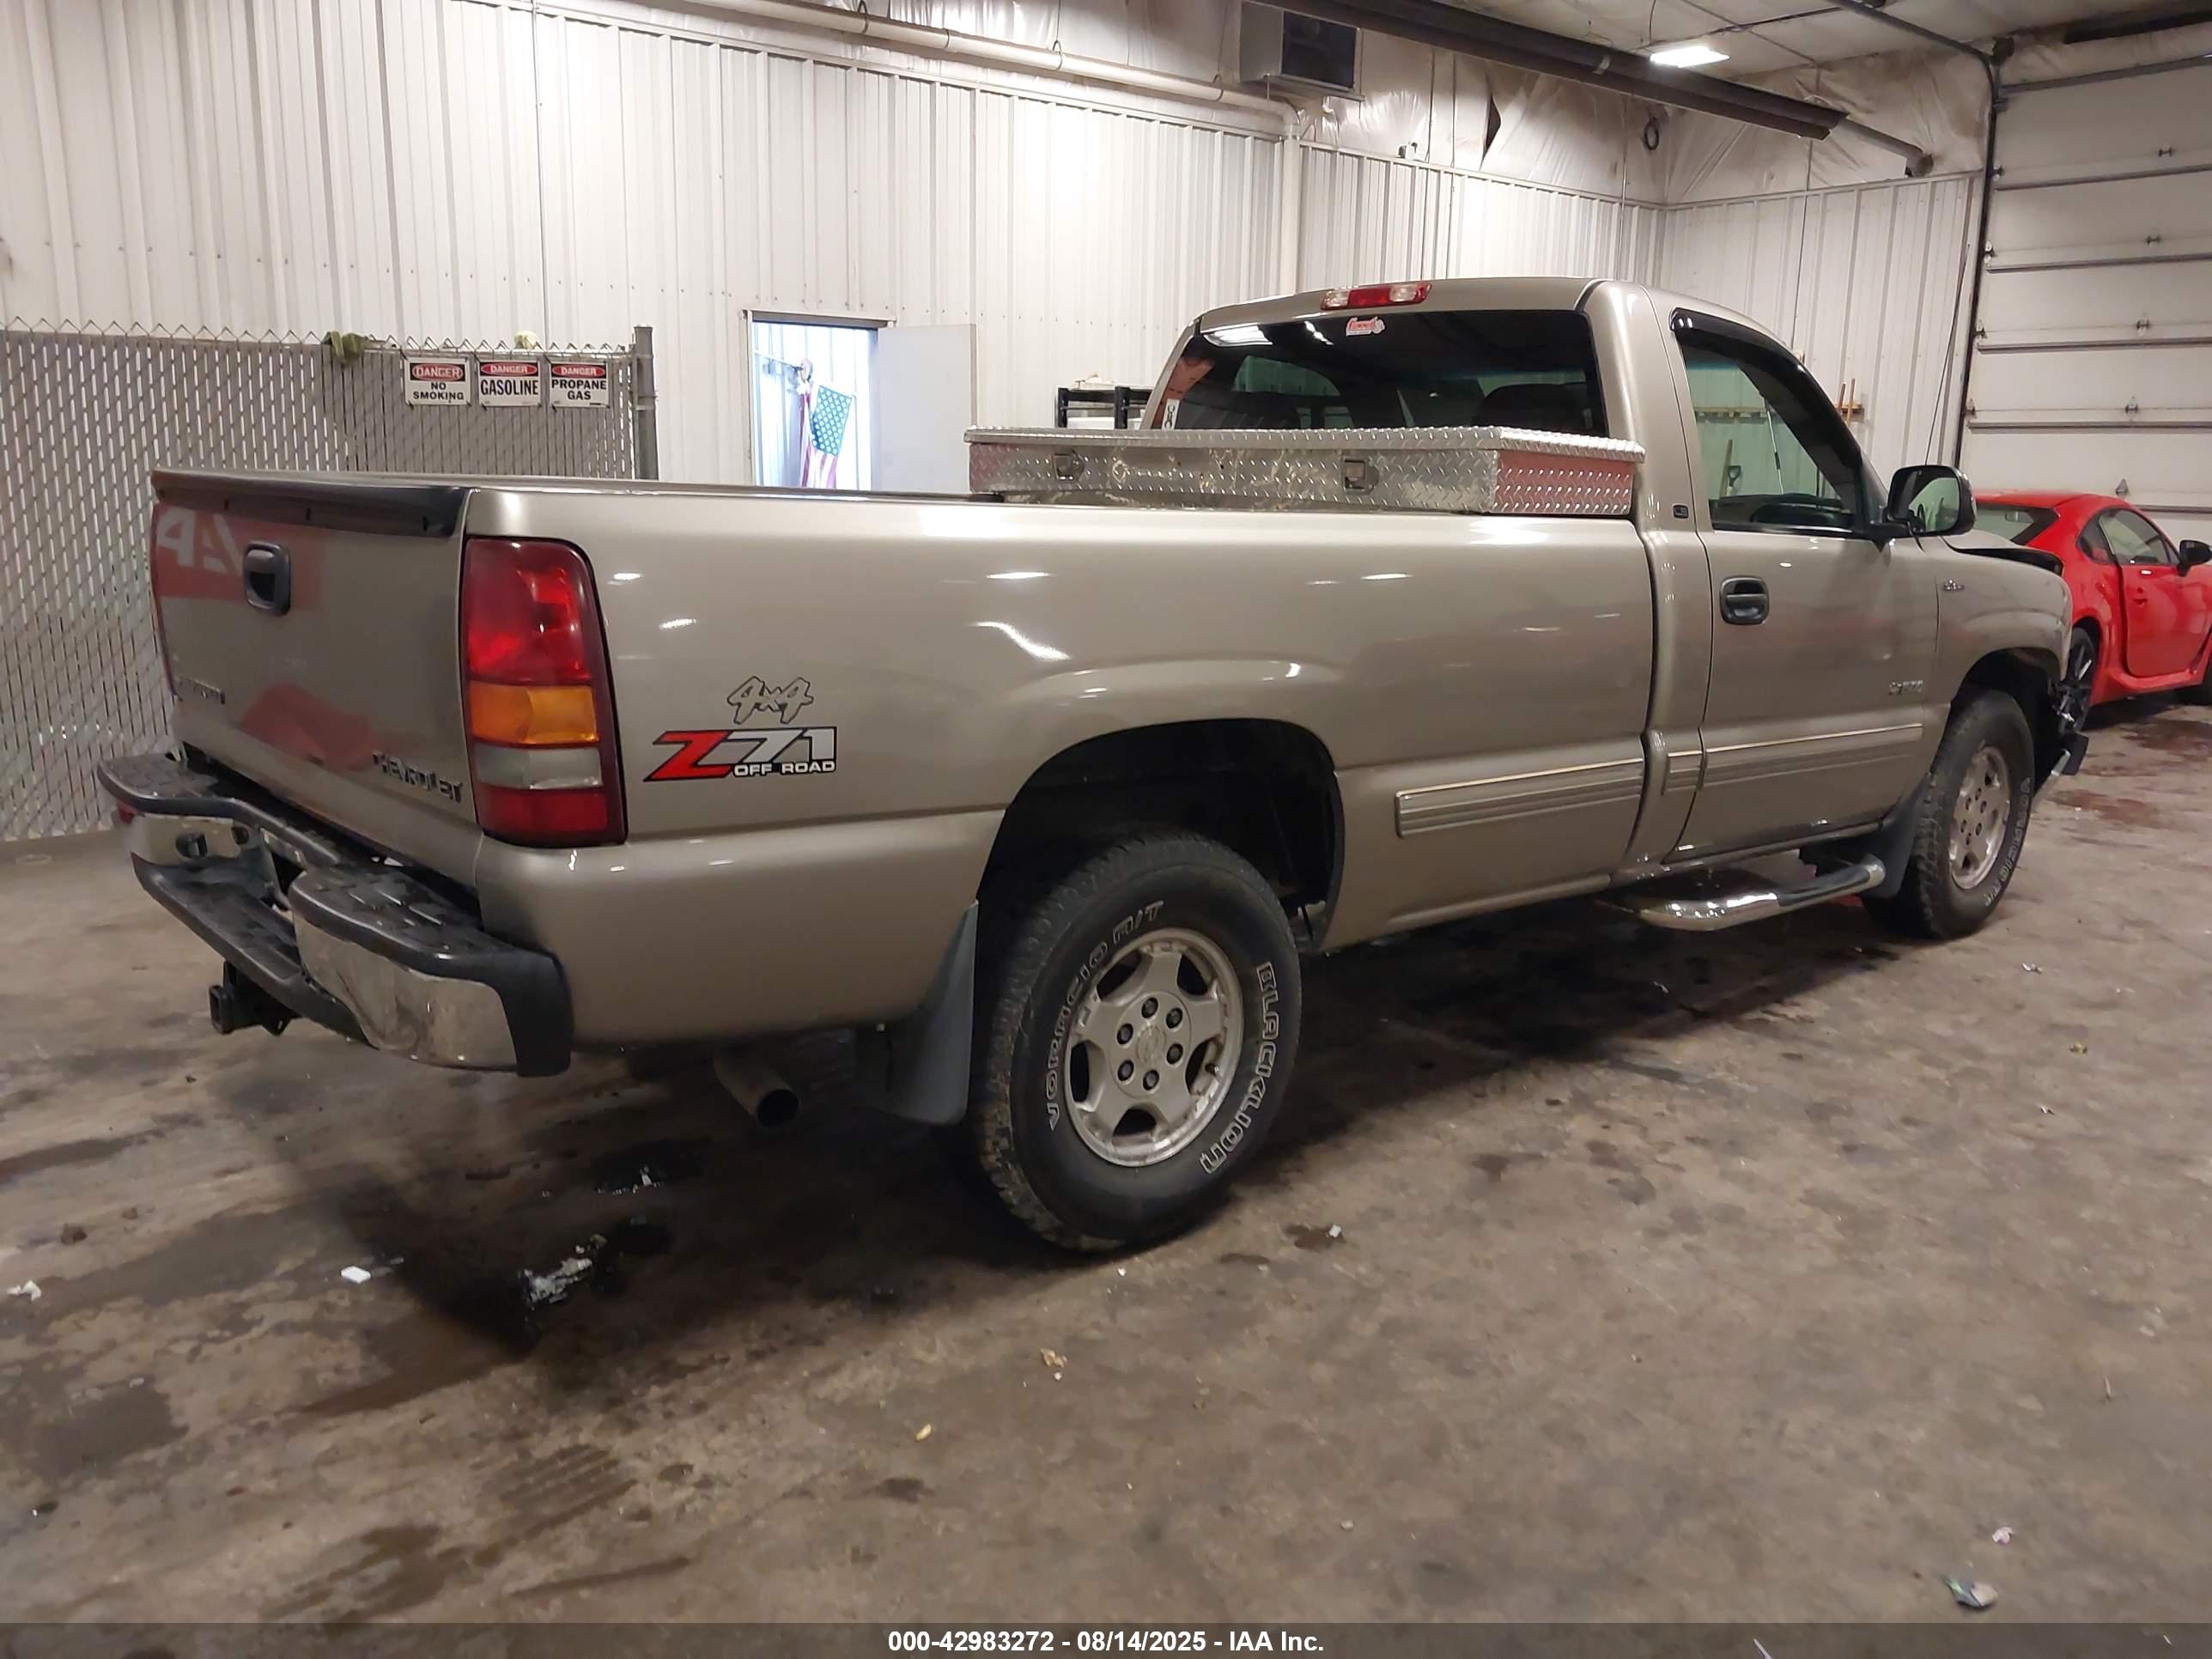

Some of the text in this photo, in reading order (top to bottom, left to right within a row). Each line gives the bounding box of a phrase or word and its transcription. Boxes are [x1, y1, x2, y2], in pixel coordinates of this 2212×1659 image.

[416, 365, 461, 379] DANGER
[490, 364, 528, 374] DANGER
[561, 367, 597, 376] DANGER
[430, 381, 447, 391] NO
[480, 379, 539, 396] GASOLINE
[551, 379, 607, 390] PROPANE
[412, 390, 465, 401] SMOKING
[567, 390, 592, 401] GAS
[643, 726, 838, 781] Z71
[733, 761, 836, 777] OFF ROAD
[1200, 961, 1279, 1175] BLACKLION
